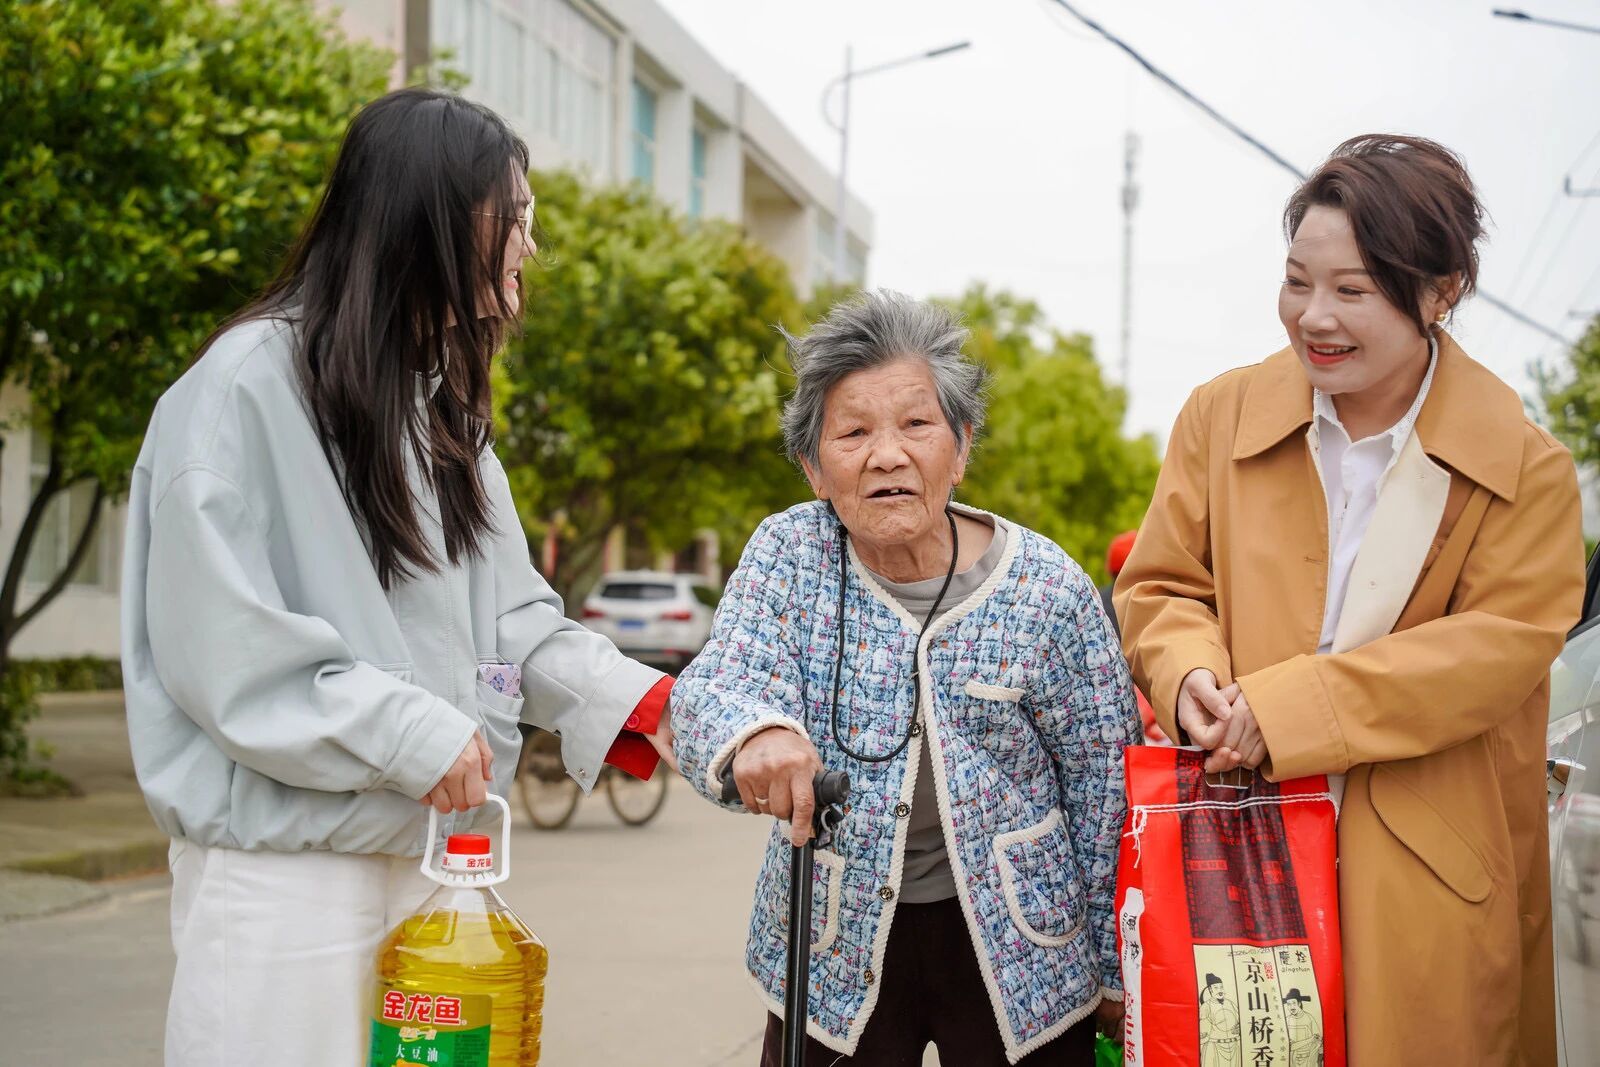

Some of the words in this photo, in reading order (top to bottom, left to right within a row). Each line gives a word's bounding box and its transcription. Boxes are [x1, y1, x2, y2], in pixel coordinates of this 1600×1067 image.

[383, 990, 461, 1026] 金龙鱼
[395, 1043, 438, 1063] 大豆油
